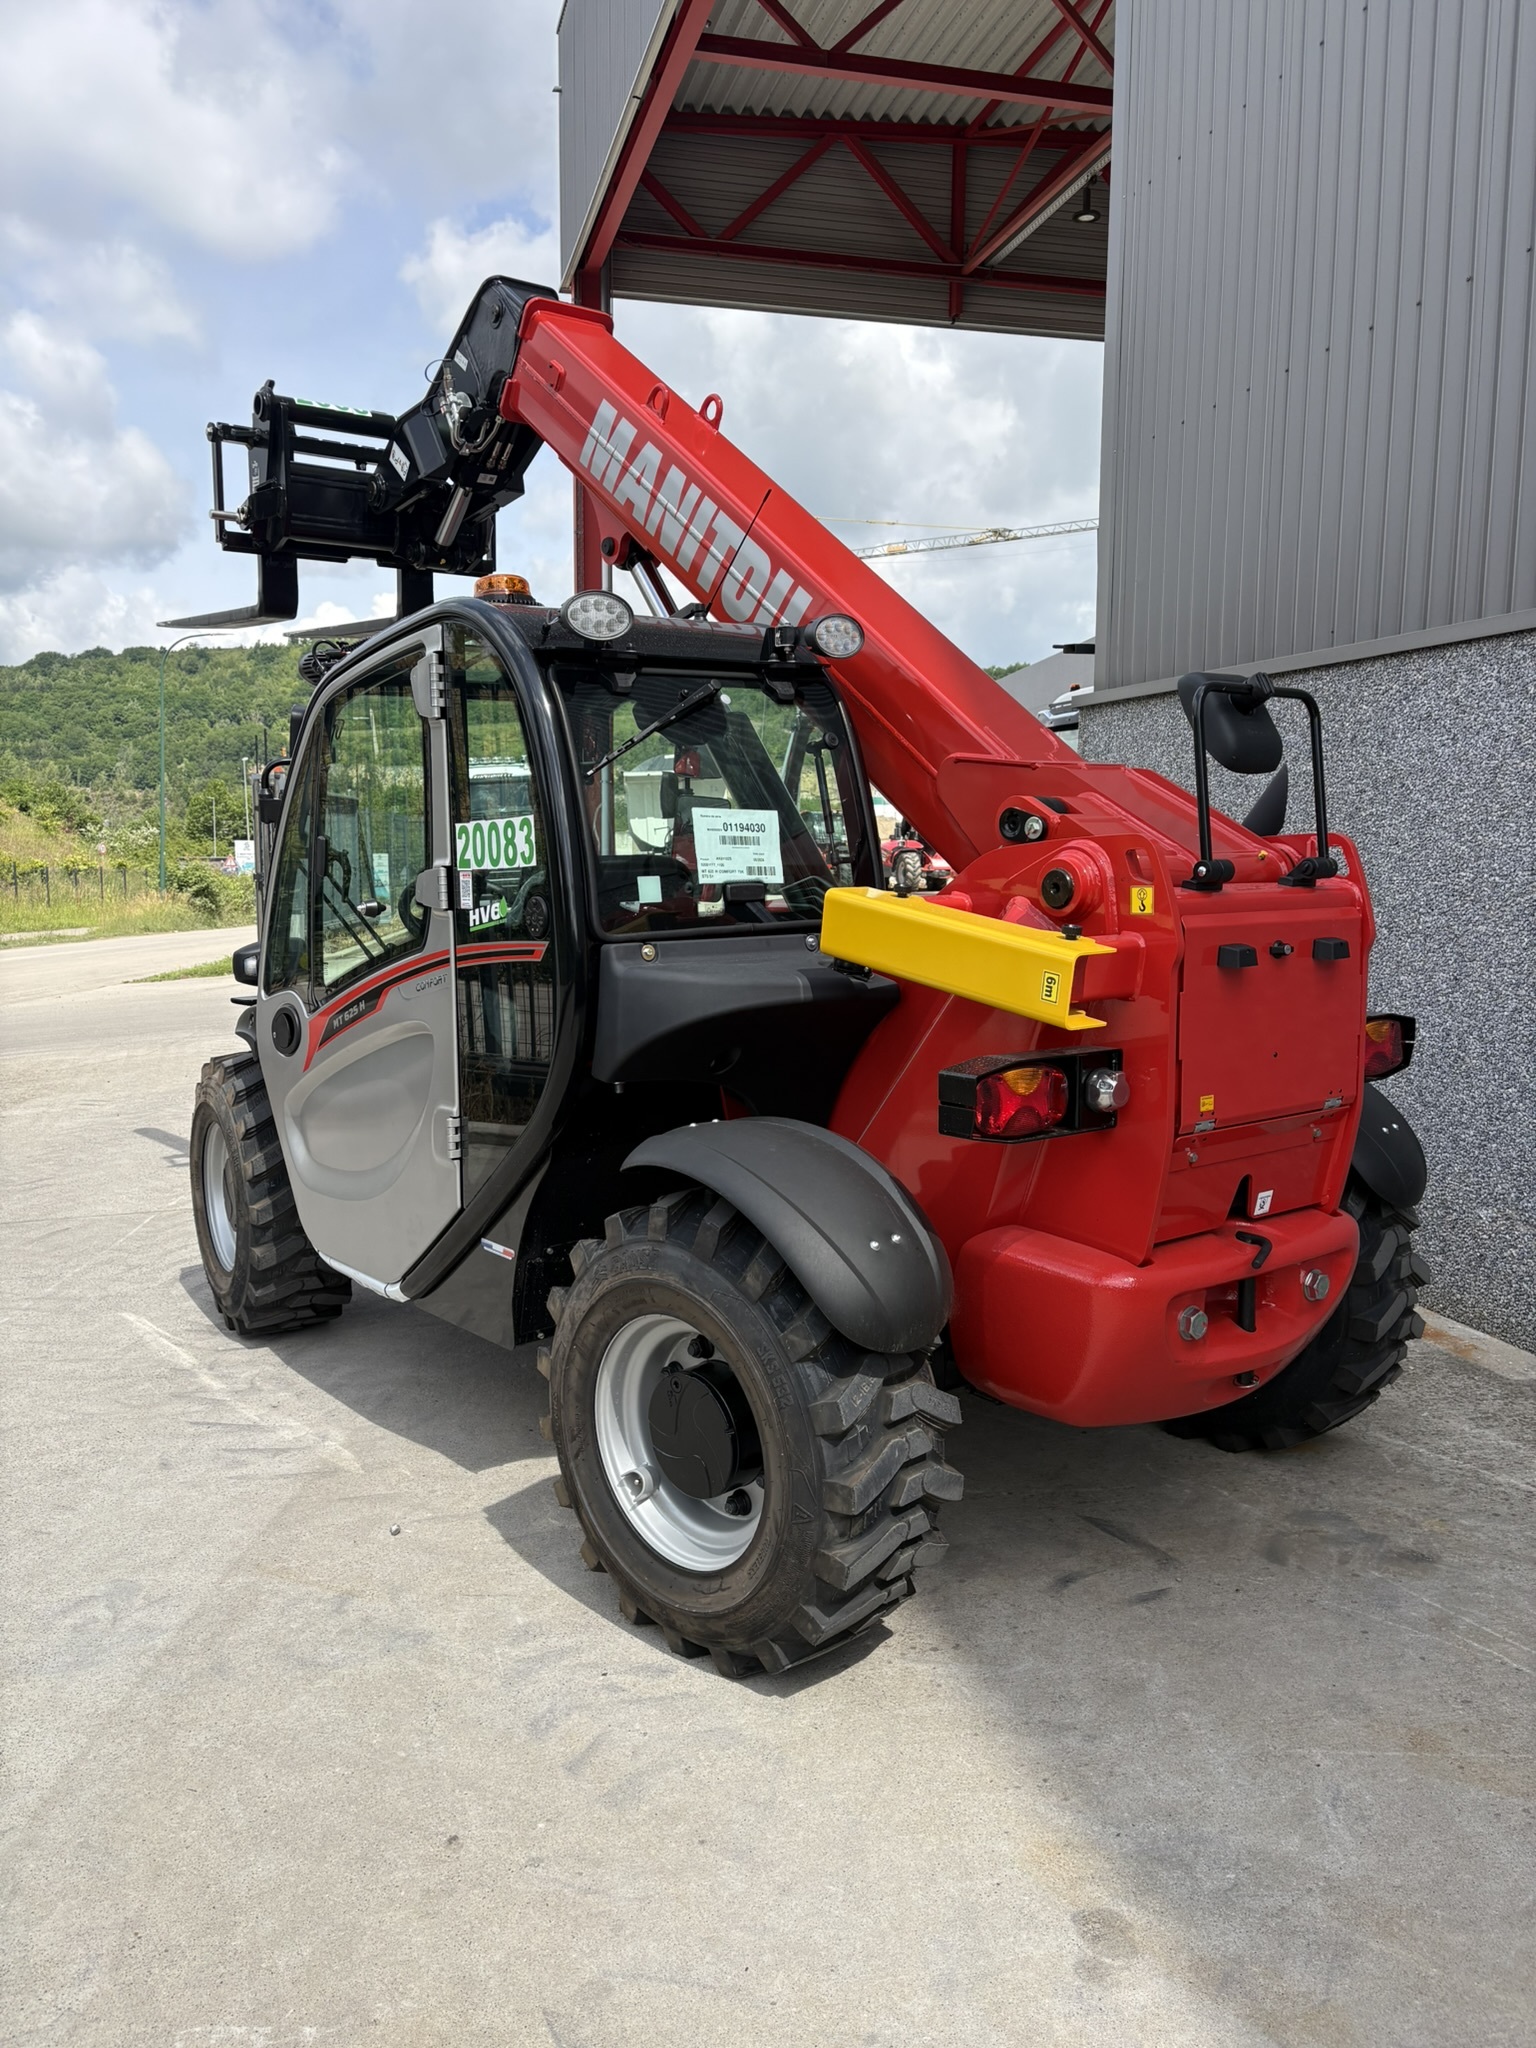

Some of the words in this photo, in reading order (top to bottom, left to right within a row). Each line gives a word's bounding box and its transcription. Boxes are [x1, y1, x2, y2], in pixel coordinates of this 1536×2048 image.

[722, 822, 766, 833] 01194030
[457, 817, 535, 869] 20083
[415, 973, 448, 992] COMFORT
[1045, 976, 1056, 998] 6m
[333, 1014, 344, 1030] MT
[344, 1004, 359, 1021] 625
[359, 999, 366, 1011] H
